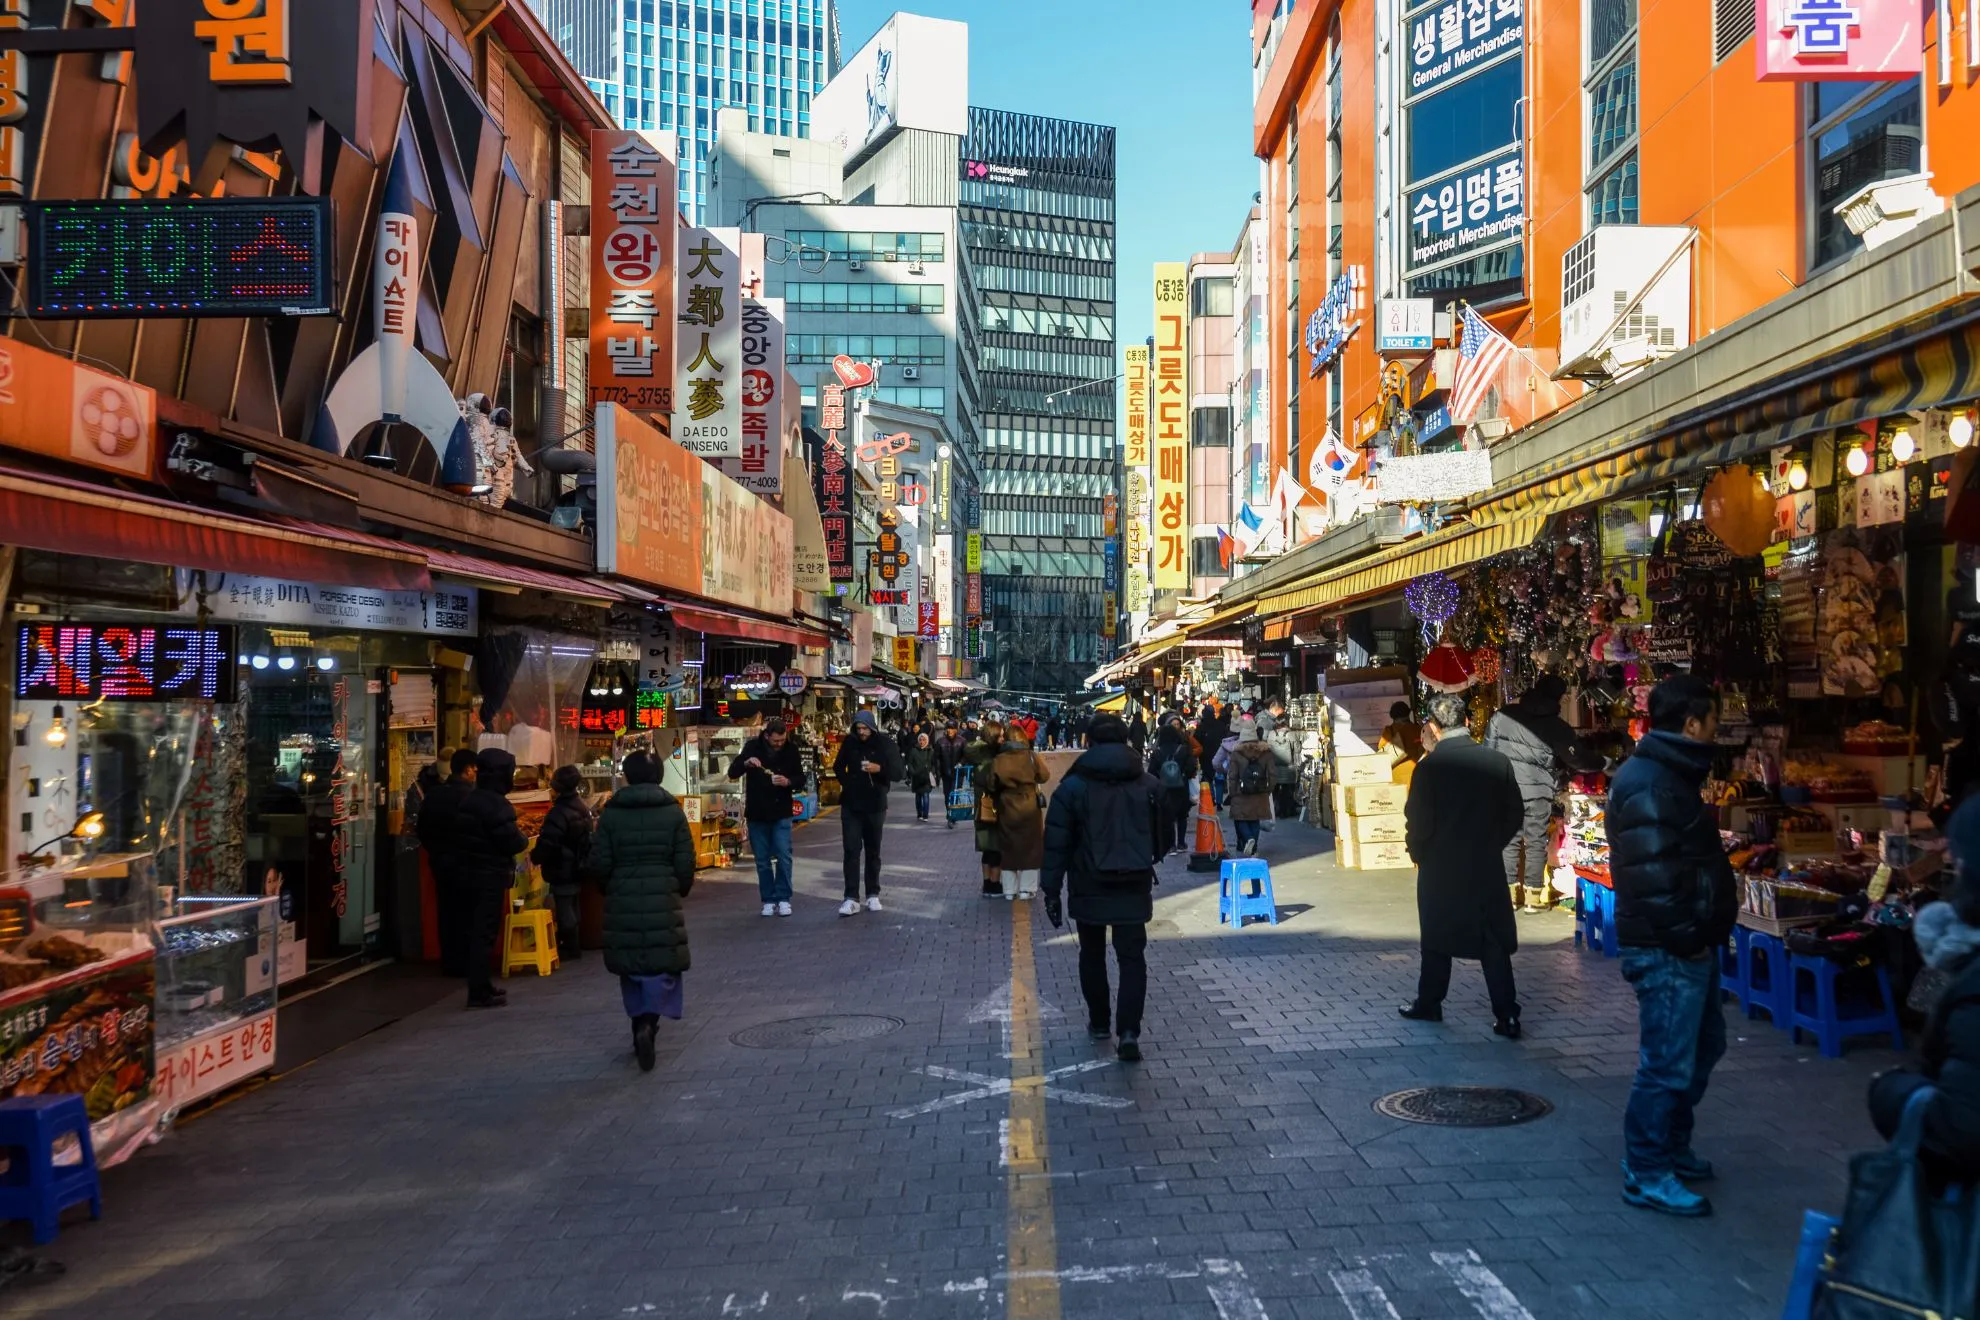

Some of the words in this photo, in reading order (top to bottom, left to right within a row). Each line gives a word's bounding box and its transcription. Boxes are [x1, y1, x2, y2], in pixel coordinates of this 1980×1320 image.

[1413, 56, 1451, 87] General
[1455, 26, 1522, 68] Merchandise
[989, 164, 1028, 177] Heungkuk
[1413, 159, 1522, 239] 수입명품
[605, 136, 661, 376] 순천왕족발
[1413, 233, 1455, 262] Imported
[1459, 212, 1522, 246] Merchandise
[383, 220, 411, 335] 카이스트
[685, 237, 724, 421] 大都人蔘
[1386, 338, 1415, 347] TOILET
[604, 387, 671, 405] 773-3755
[742, 305, 774, 473] 중앙왕족발
[1129, 365, 1145, 461] 그릇도매상가
[680, 441, 728, 452] GINSENG
[683, 427, 728, 437] DAEDO
[1159, 315, 1184, 572] 그릇도매상가
[278, 583, 311, 604] DITA
[794, 562, 824, 573] 도안경
[320, 590, 357, 603] PORSCHE
[358, 596, 385, 608] DESIGN
[156, 1035, 234, 1100] 카이스트
[241, 1014, 274, 1062] 안경
